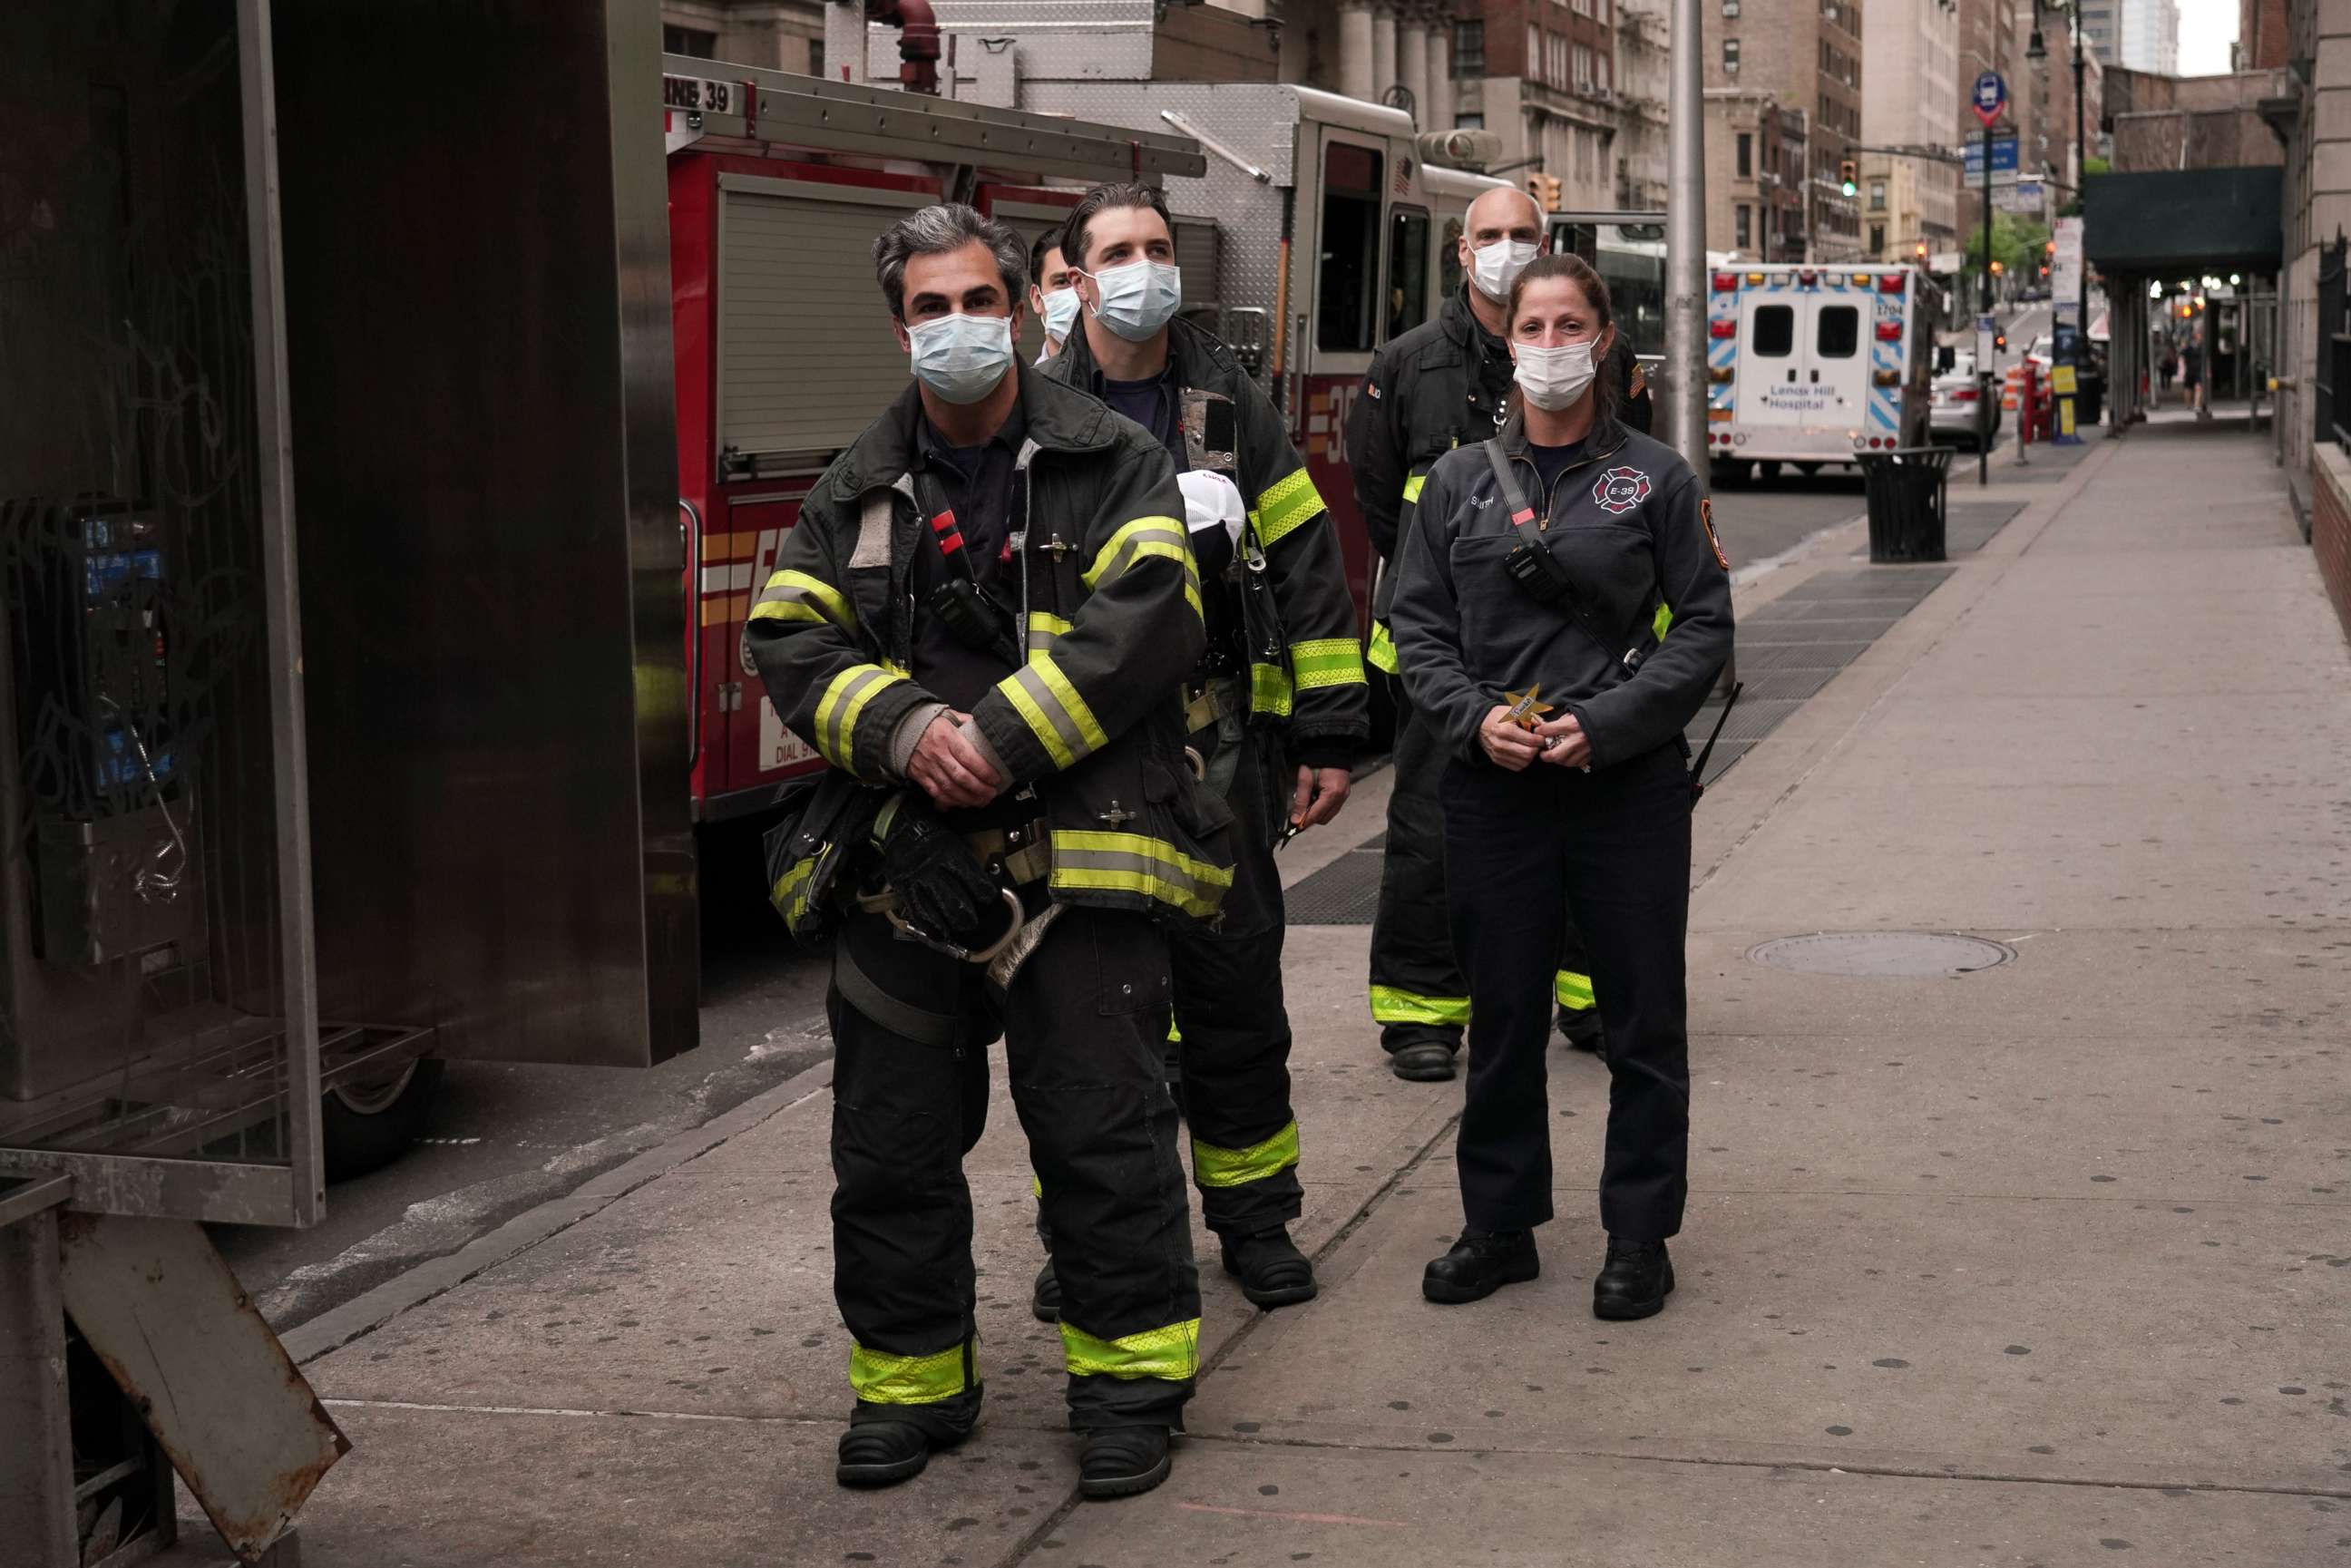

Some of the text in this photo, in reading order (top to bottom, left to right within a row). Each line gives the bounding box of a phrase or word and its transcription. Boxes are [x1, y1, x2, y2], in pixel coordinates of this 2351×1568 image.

[706, 82, 728, 112] 39
[1771, 385, 1835, 396] Lenox Hill
[1770, 399, 1824, 410] Hospital
[776, 742, 815, 764] DIAL 91
